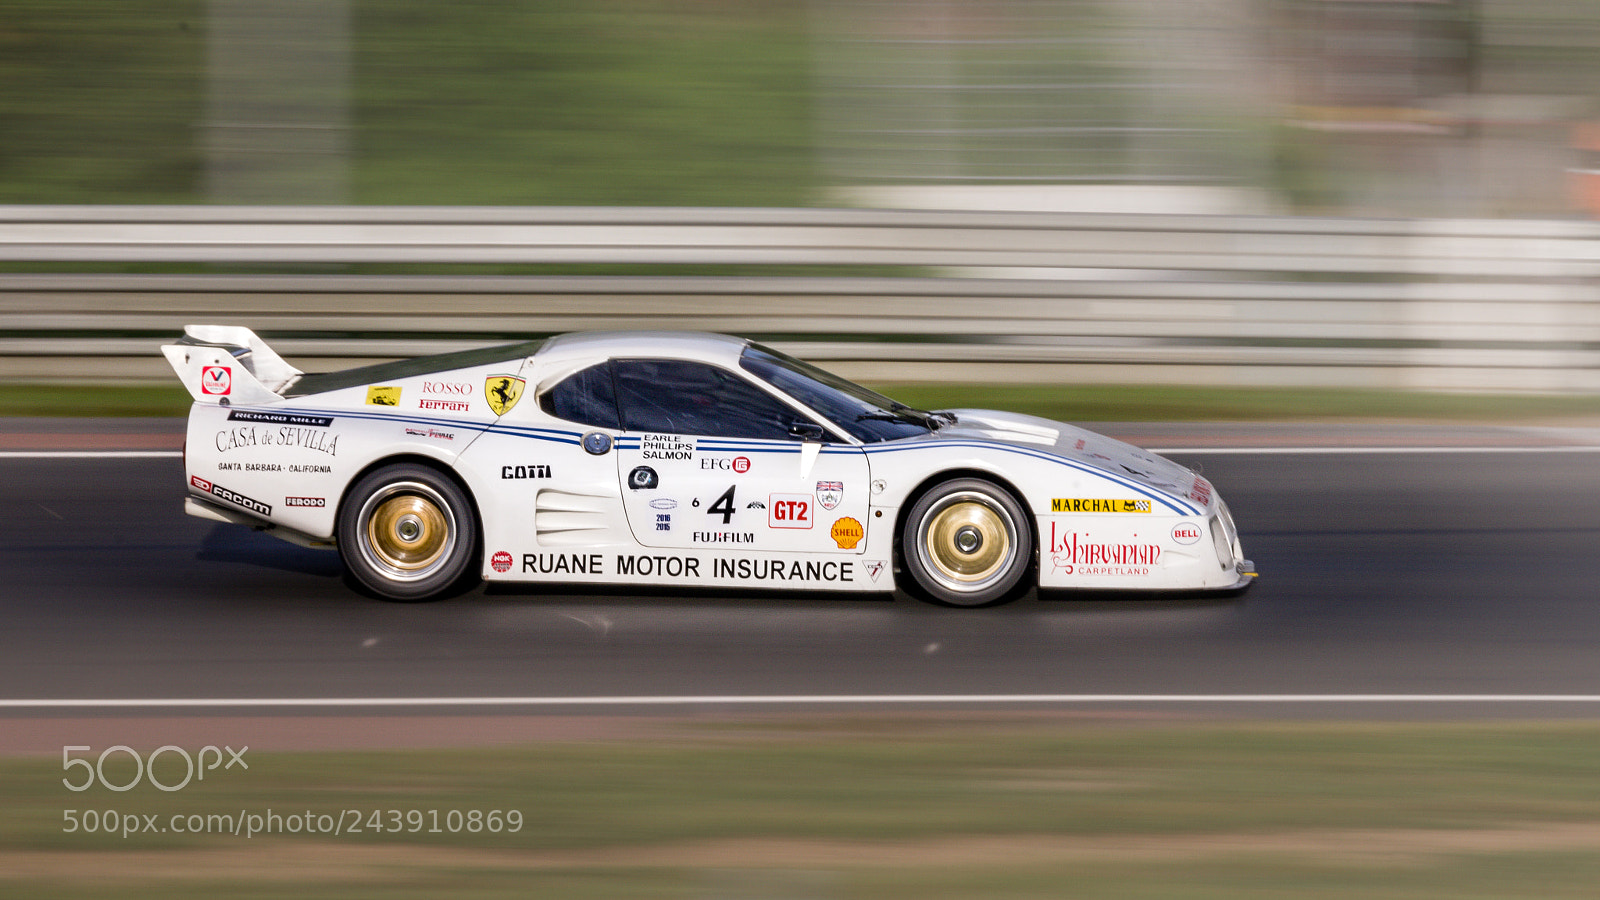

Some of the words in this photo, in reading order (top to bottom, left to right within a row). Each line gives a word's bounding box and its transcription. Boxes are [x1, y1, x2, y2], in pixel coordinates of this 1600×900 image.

[422, 381, 473, 396] ROSSO
[418, 399, 469, 412] Ferrari
[234, 412, 287, 422] RICHARD
[290, 416, 326, 424] MILLE
[215, 426, 257, 453] CASA
[261, 430, 273, 445] de
[276, 426, 340, 457] SEVILLA
[644, 434, 681, 442] EARLE
[643, 442, 693, 451] PHILLIPS
[642, 451, 692, 461] SALMON
[218, 463, 242, 471] SANTA
[245, 463, 282, 472] BARBARA
[289, 464, 332, 473] CALIFORNIA
[700, 458, 731, 470] EFG
[213, 486, 270, 515] FACOM
[287, 497, 326, 507] FERODO
[691, 497, 700, 508] 6
[707, 484, 736, 525] 4
[1051, 499, 1118, 512] MARCHAL
[774, 500, 808, 521] GT2
[655, 522, 671, 531] 2015
[834, 528, 860, 537] SHELL
[693, 531, 754, 543] FUJIFILM
[1174, 529, 1199, 538] BELL
[522, 553, 603, 575] RUANE
[617, 555, 700, 578] MOTOR
[713, 557, 854, 582] INSURANCE
[1078, 566, 1149, 575] CARPETLAND
